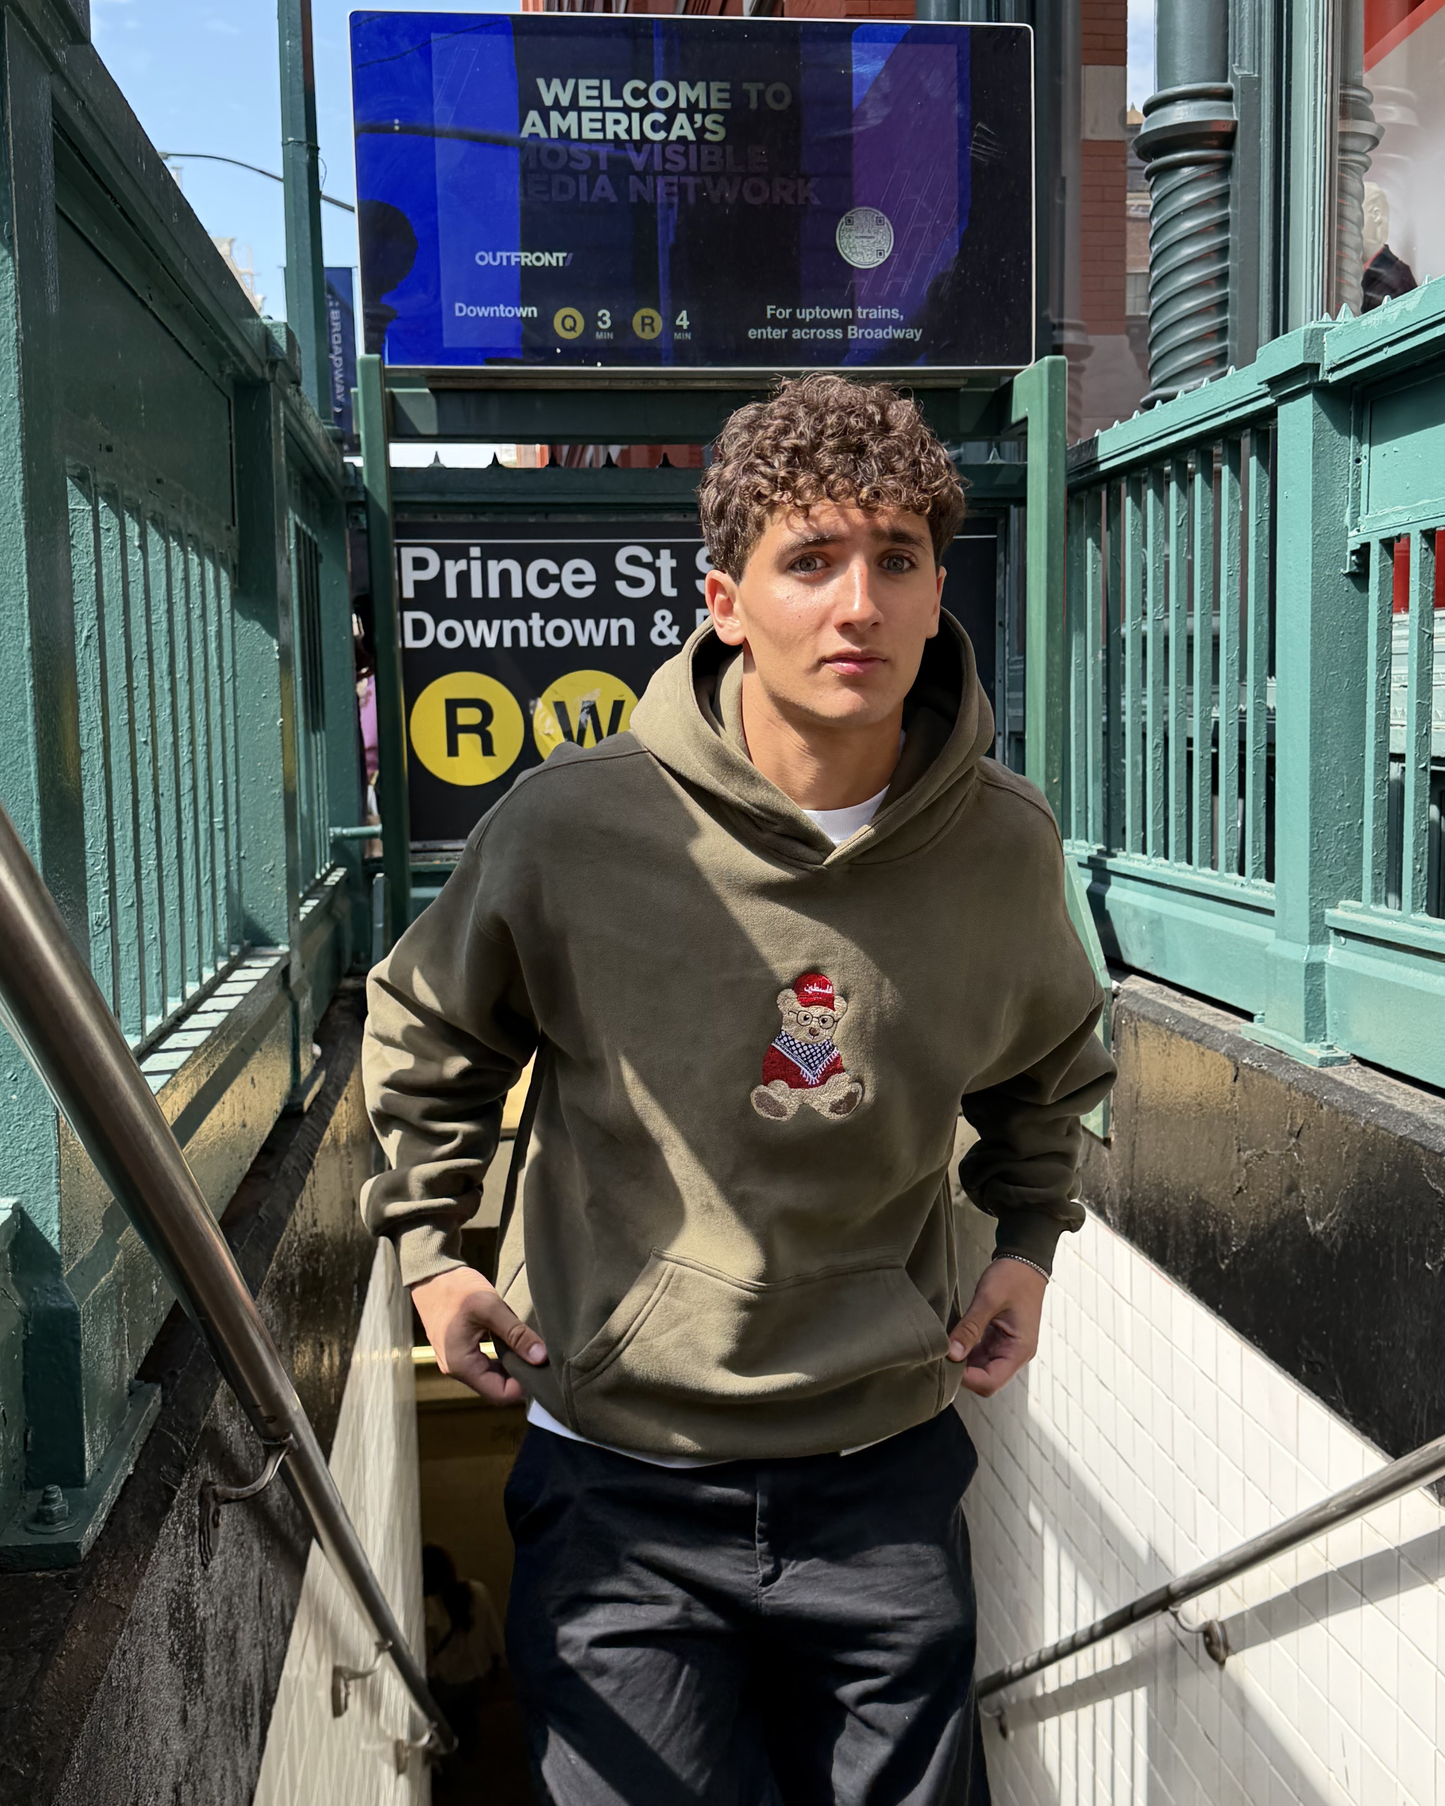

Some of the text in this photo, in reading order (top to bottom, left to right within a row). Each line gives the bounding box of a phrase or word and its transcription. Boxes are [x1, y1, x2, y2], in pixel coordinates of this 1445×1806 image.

[536, 78, 792, 111] WELCOME TO
[520, 110, 726, 141] AMERICA'S
[624, 143, 769, 173] VISIBLE
[628, 175, 821, 206] NETWORK
[454, 302, 538, 318] Downtown
[561, 309, 612, 333] Q 3
[640, 310, 690, 333] R 4
[766, 305, 904, 322] For uptown trains,
[595, 331, 614, 340] MIN
[674, 332, 692, 340] MIN
[748, 325, 923, 342] enter across Broadway
[329, 309, 345, 403] BROADWAY
[401, 546, 597, 599] Prince
[614, 546, 678, 599] St
[403, 610, 635, 649] Downtown
[650, 608, 682, 646] &
[444, 697, 625, 758] R W
